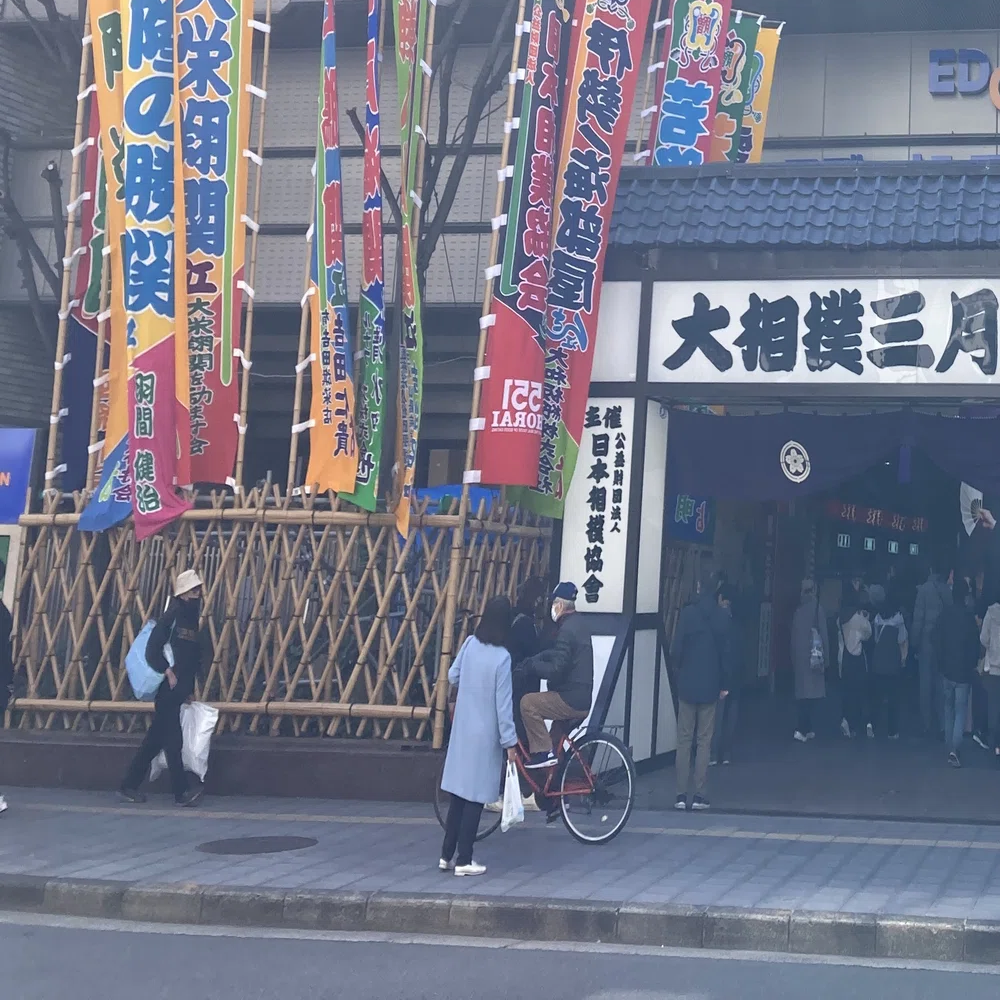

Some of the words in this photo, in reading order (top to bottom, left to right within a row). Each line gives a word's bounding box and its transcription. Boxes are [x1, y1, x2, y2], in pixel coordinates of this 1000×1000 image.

[583, 405, 623, 430] 主催
[581, 433, 610, 605] 日本相撲協会
[610, 432, 627, 534] 公益財団法人
